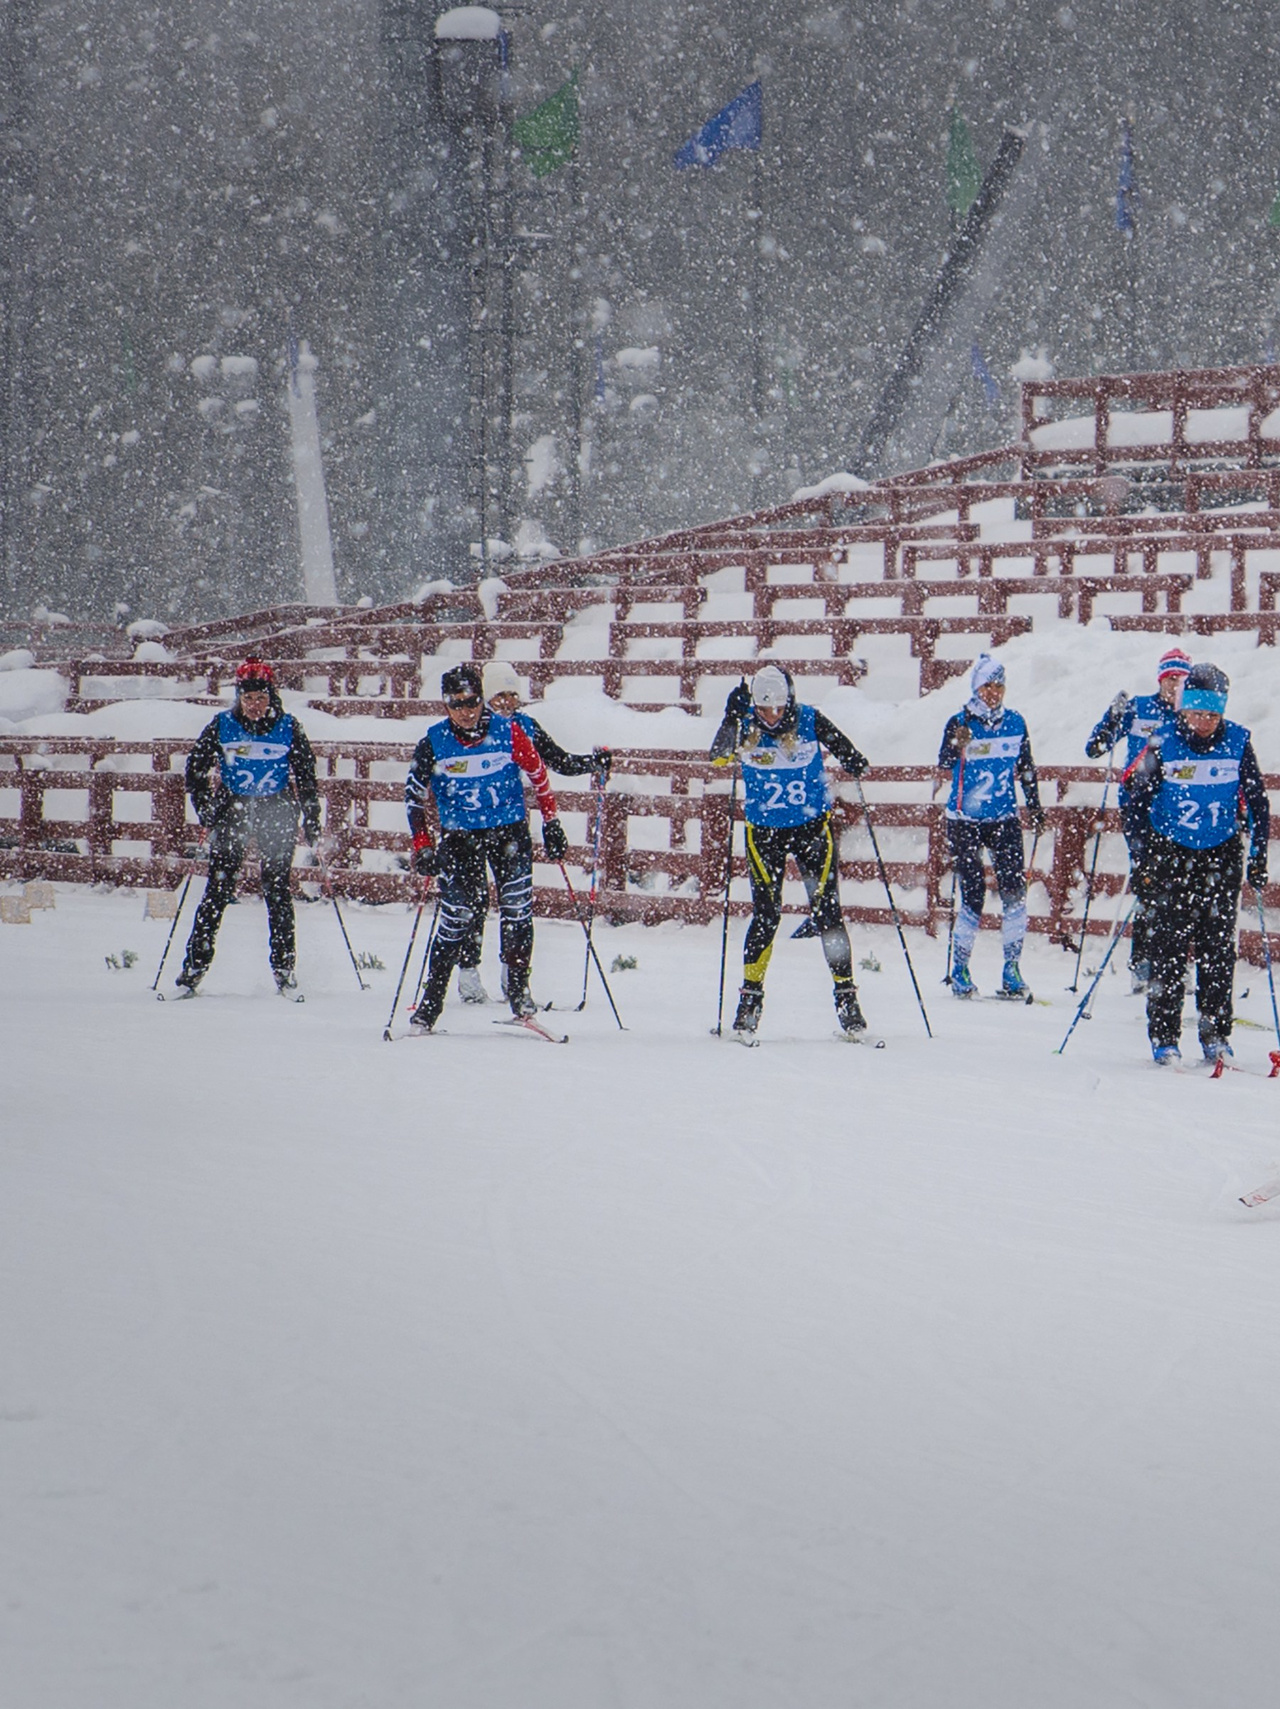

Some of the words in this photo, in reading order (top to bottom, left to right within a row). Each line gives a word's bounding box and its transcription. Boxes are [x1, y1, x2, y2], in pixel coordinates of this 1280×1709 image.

[457, 786, 500, 811] 31
[763, 780, 808, 811] 28
[973, 768, 1010, 800] 23
[1178, 800, 1221, 830] 21
